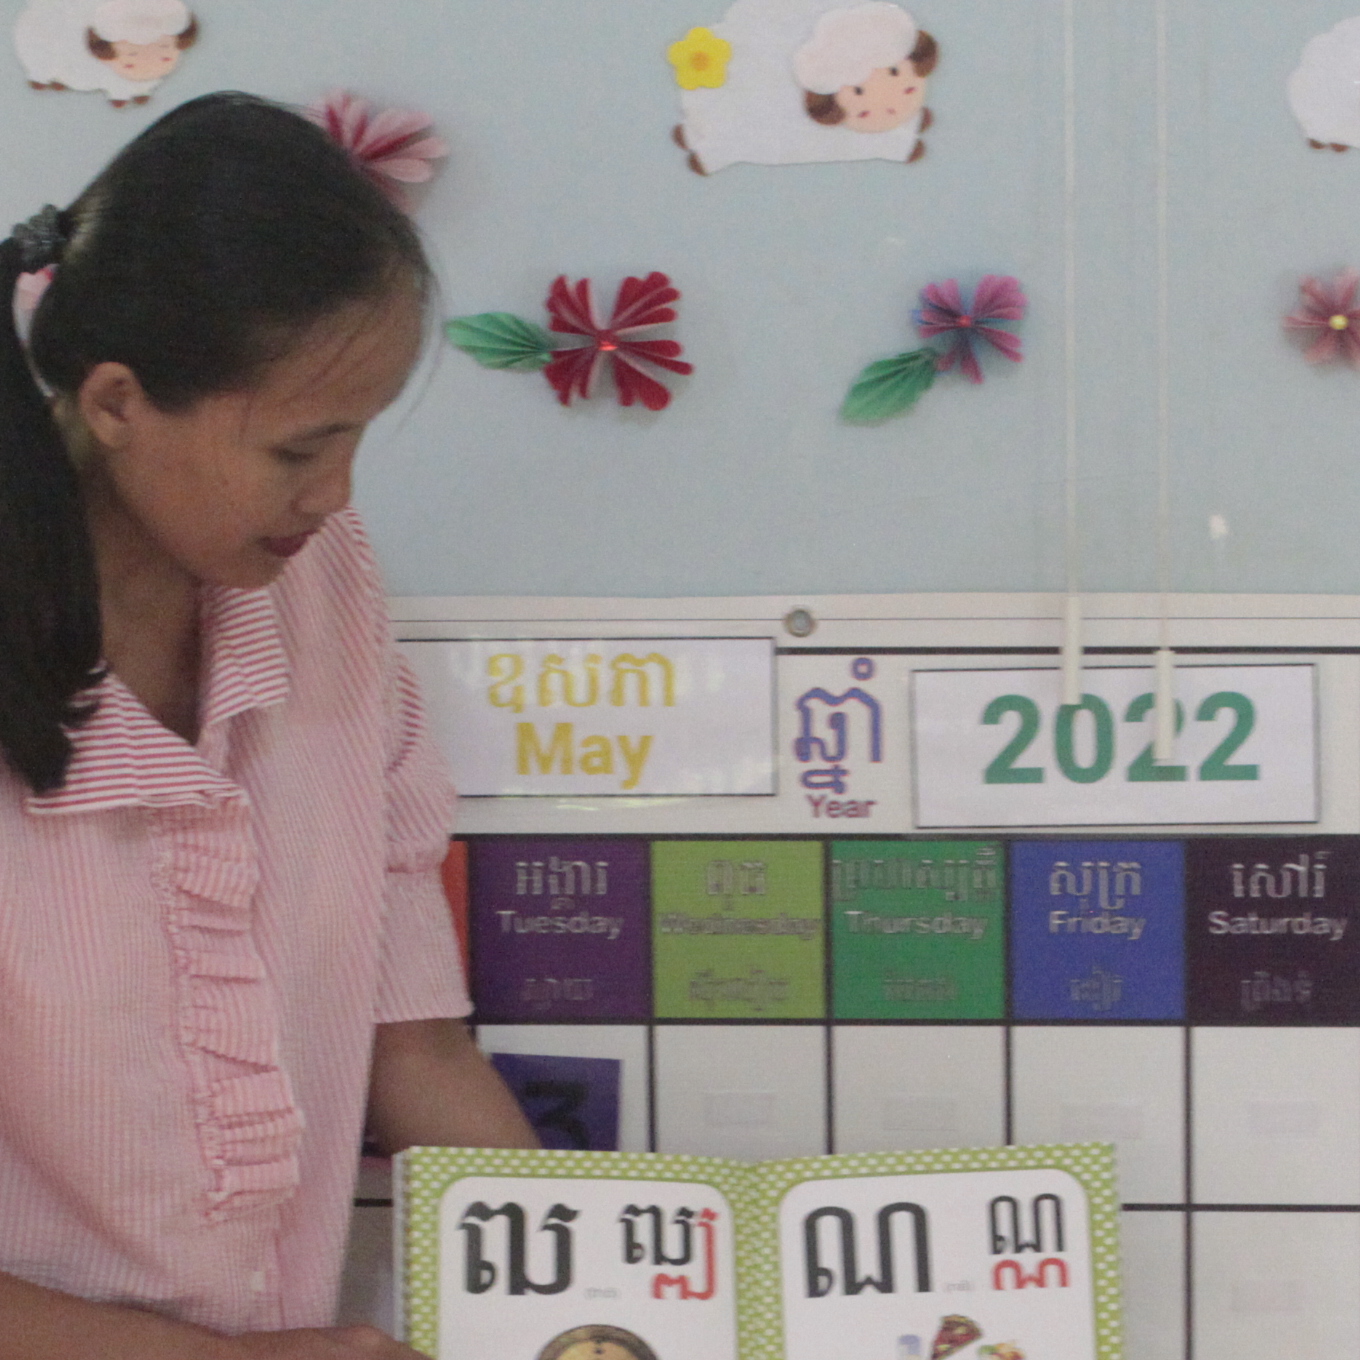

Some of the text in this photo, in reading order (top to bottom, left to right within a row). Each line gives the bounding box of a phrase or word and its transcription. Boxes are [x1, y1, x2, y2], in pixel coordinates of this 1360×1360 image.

[981, 691, 1261, 785] 2022
[515, 722, 655, 790] May
[804, 795, 878, 819] Year
[495, 910, 624, 940] Tuesday
[843, 910, 987, 939] Thursday
[1048, 910, 1146, 940] Friday
[1207, 910, 1347, 941] Saturday
